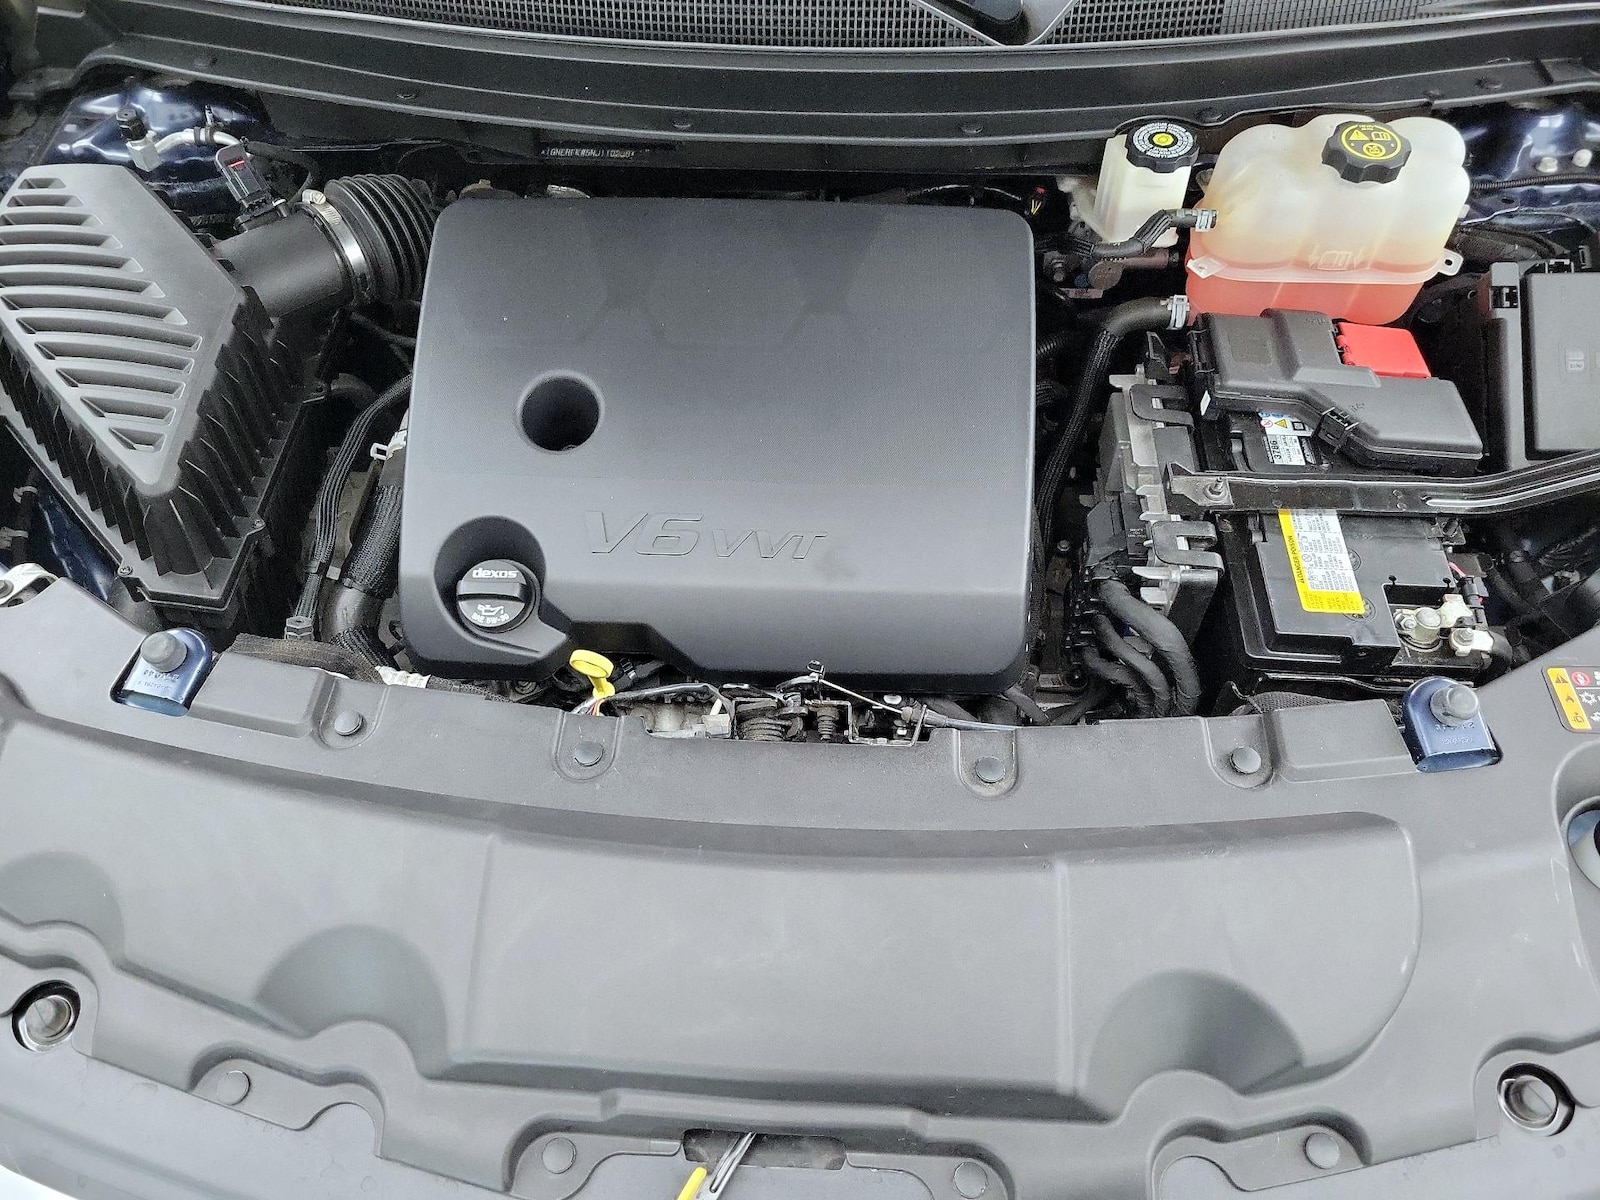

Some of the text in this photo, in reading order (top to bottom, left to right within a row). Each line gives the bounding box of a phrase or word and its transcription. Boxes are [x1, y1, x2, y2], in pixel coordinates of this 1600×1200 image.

[1269, 440, 1282, 460] 3786
[585, 509, 704, 556] V6
[472, 567, 519, 579] dexos
[1292, 556, 1304, 579] DANGER
